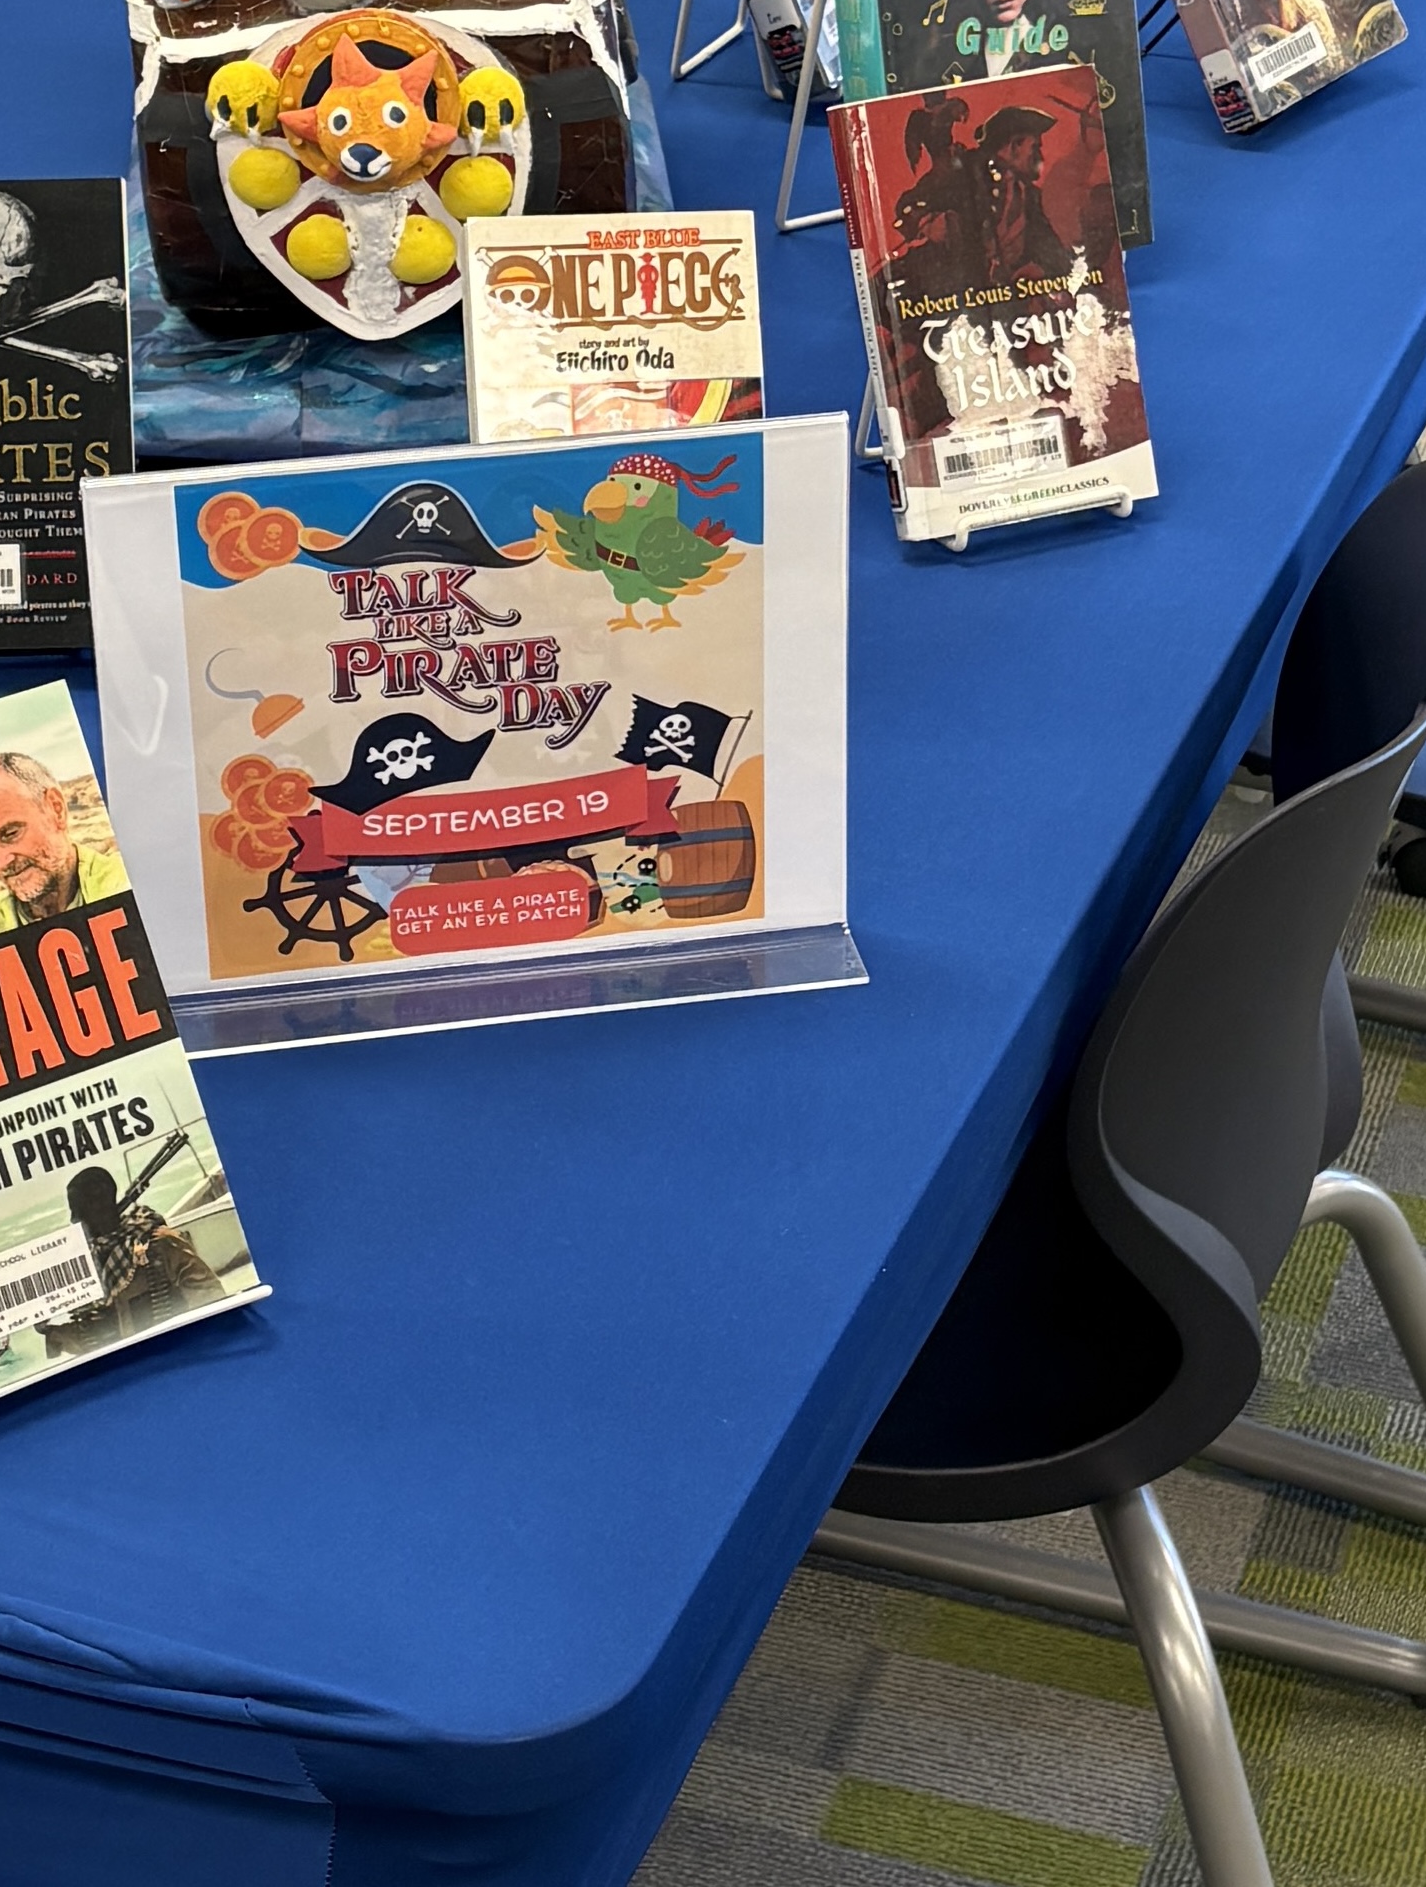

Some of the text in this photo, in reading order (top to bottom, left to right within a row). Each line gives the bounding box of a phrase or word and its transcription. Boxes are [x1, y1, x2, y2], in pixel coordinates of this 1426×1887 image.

[956, 15, 1070, 56] Guide
[586, 228, 701, 250] EAST BLUE
[484, 248, 746, 322] ONE PIECE
[898, 269, 1104, 320] Robert Louis Stevenon
[578, 336, 650, 350] story and art by
[919, 306, 1096, 364] Treasure
[555, 347, 675, 374] Eiichiro Oda
[951, 347, 1078, 412] Island
[24, 508, 77, 521] PIRATES
[45, 524, 83, 537] THEM
[329, 567, 521, 627] TALK
[33, 614, 69, 623] REVIEW
[374, 609, 483, 649] LIKE A
[326, 635, 561, 713] PIRATE
[497, 680, 612, 750] DAY
[362, 790, 609, 837] SEPTEMBER 19
[393, 888, 585, 920] TALK LIKE A PIRATE.
[396, 904, 581, 936] GET AN EYE PATCH
[69, 1078, 120, 1110] WITH
[11, 1097, 155, 1182] PIRATES
[30, 1236, 69, 1258] LIBRARY
[7, 1316, 29, 1332] year
[48, 1291, 92, 1314] gunpoint
